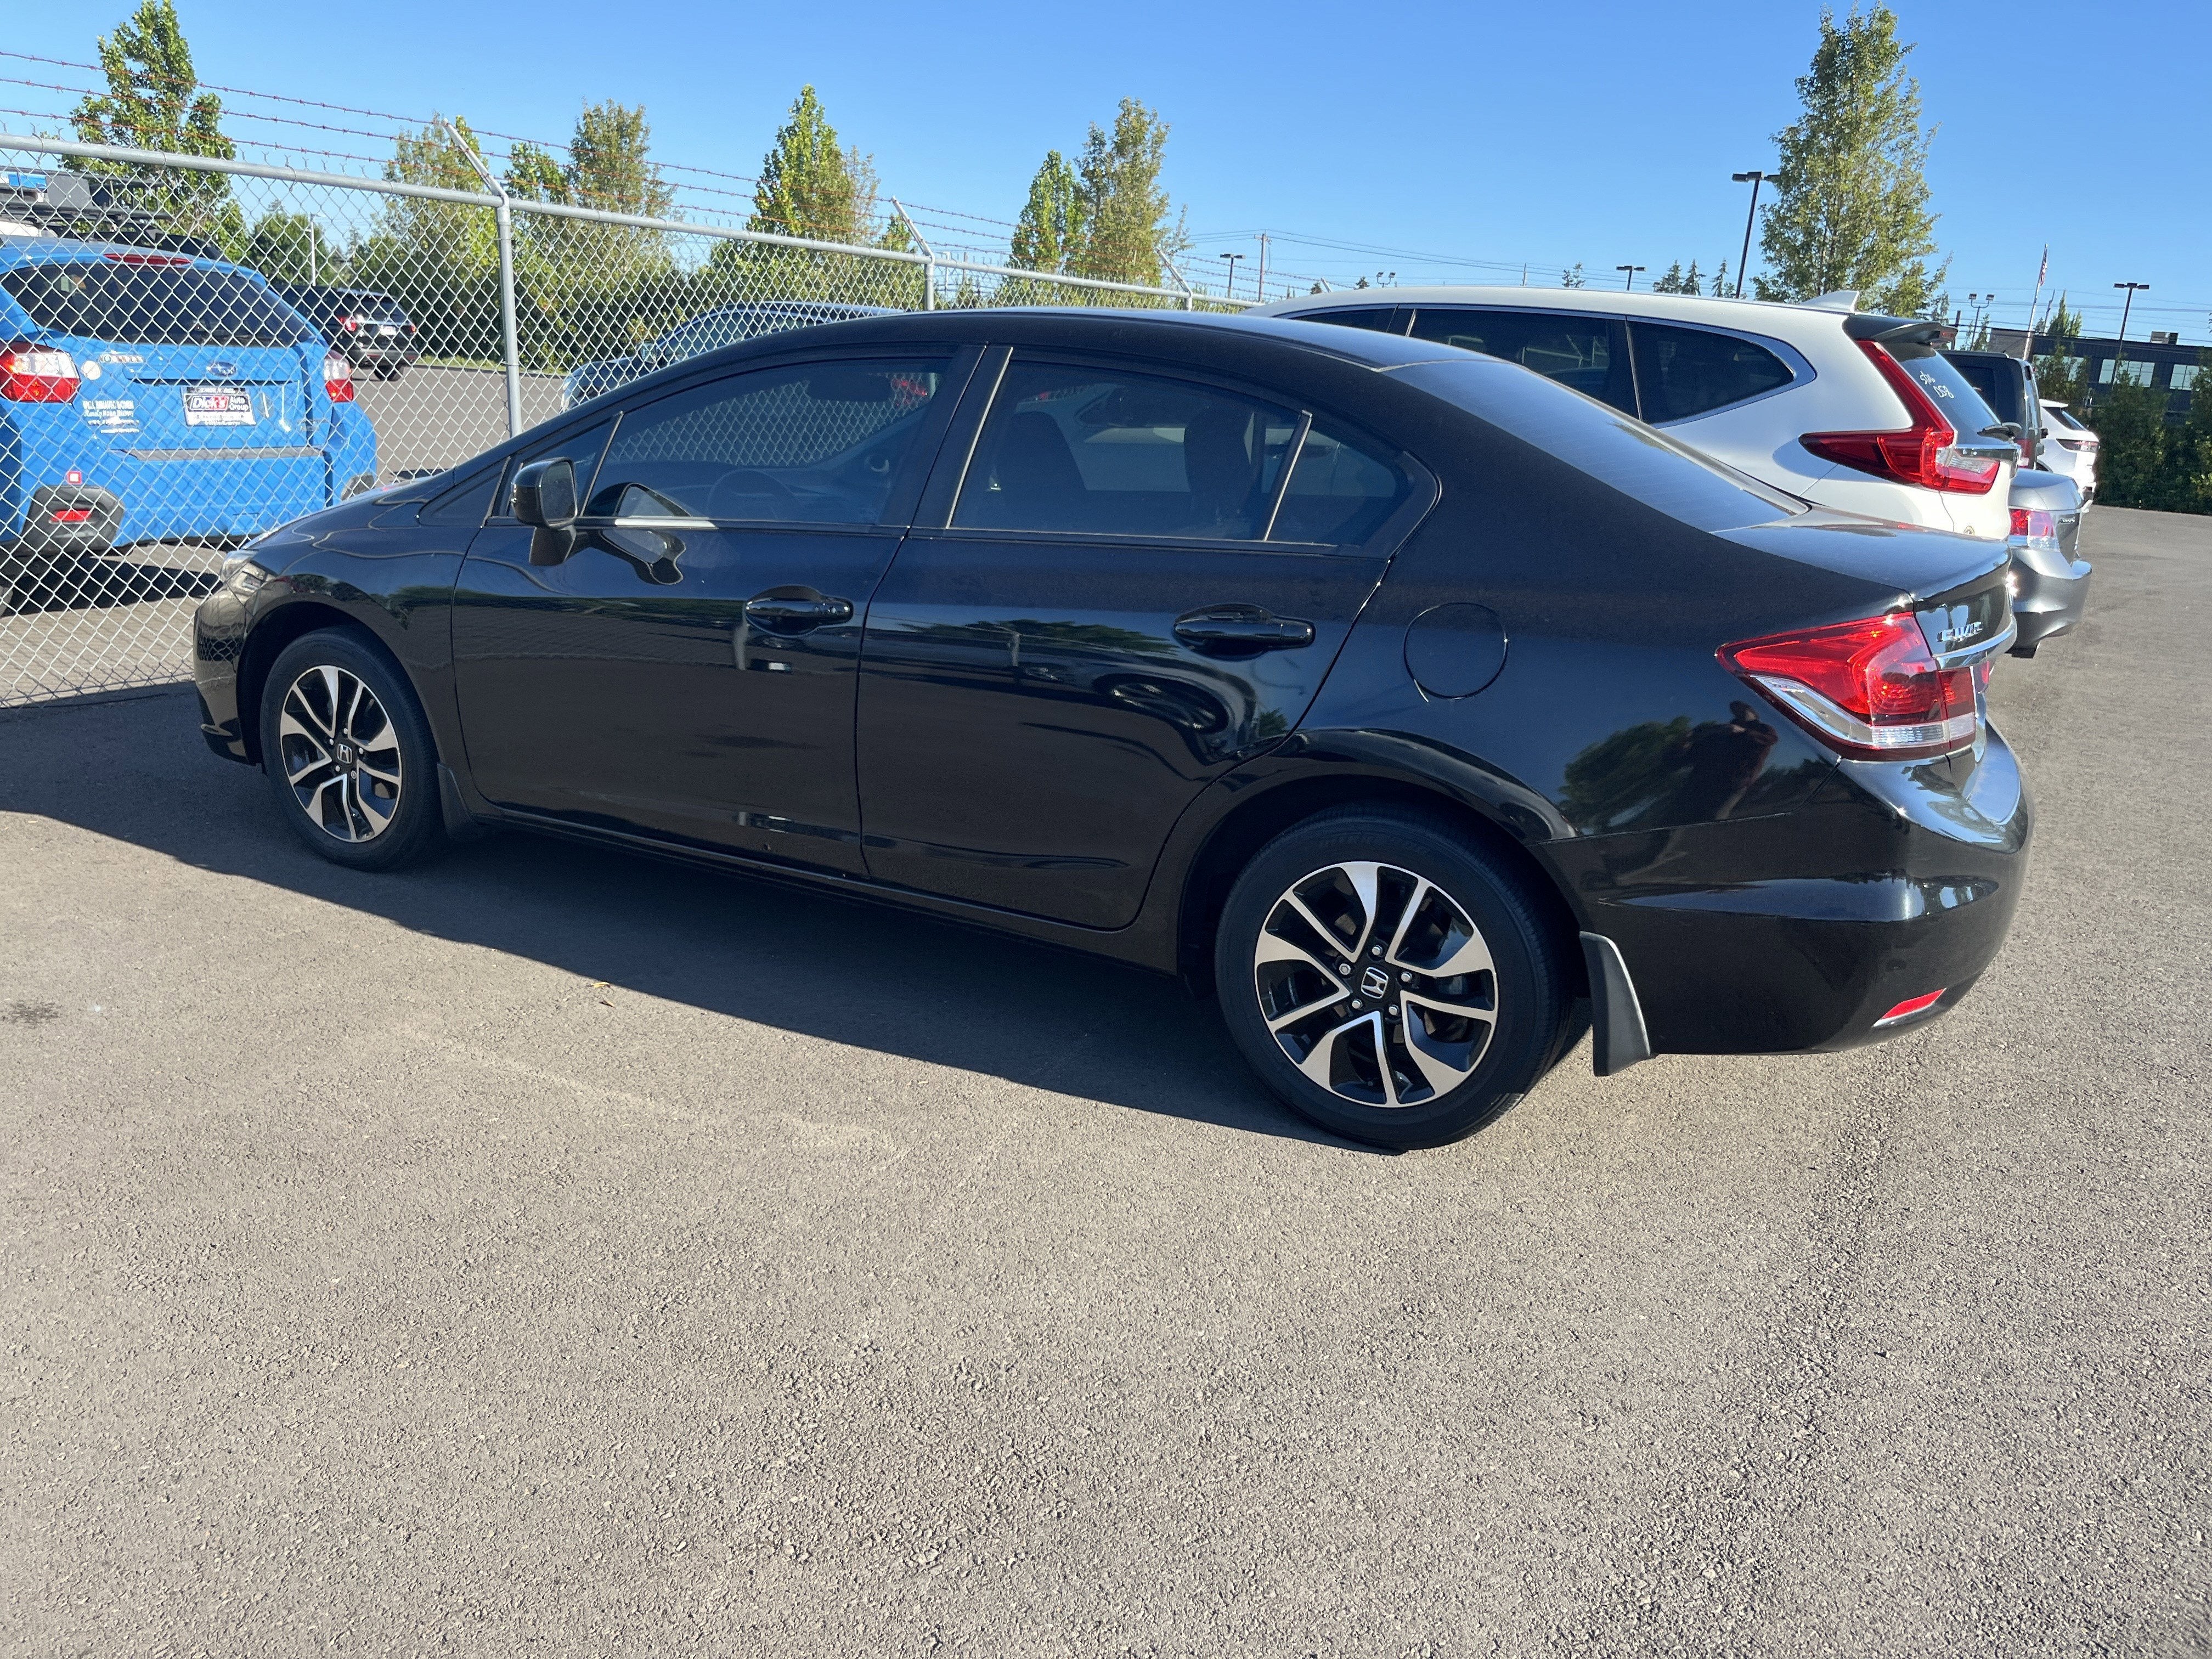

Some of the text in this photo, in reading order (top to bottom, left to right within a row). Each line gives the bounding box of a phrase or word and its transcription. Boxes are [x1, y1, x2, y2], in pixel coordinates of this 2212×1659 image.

[192, 396, 227, 408] Dick's
[230, 396, 246, 404] Auto
[229, 403, 250, 411] Group
